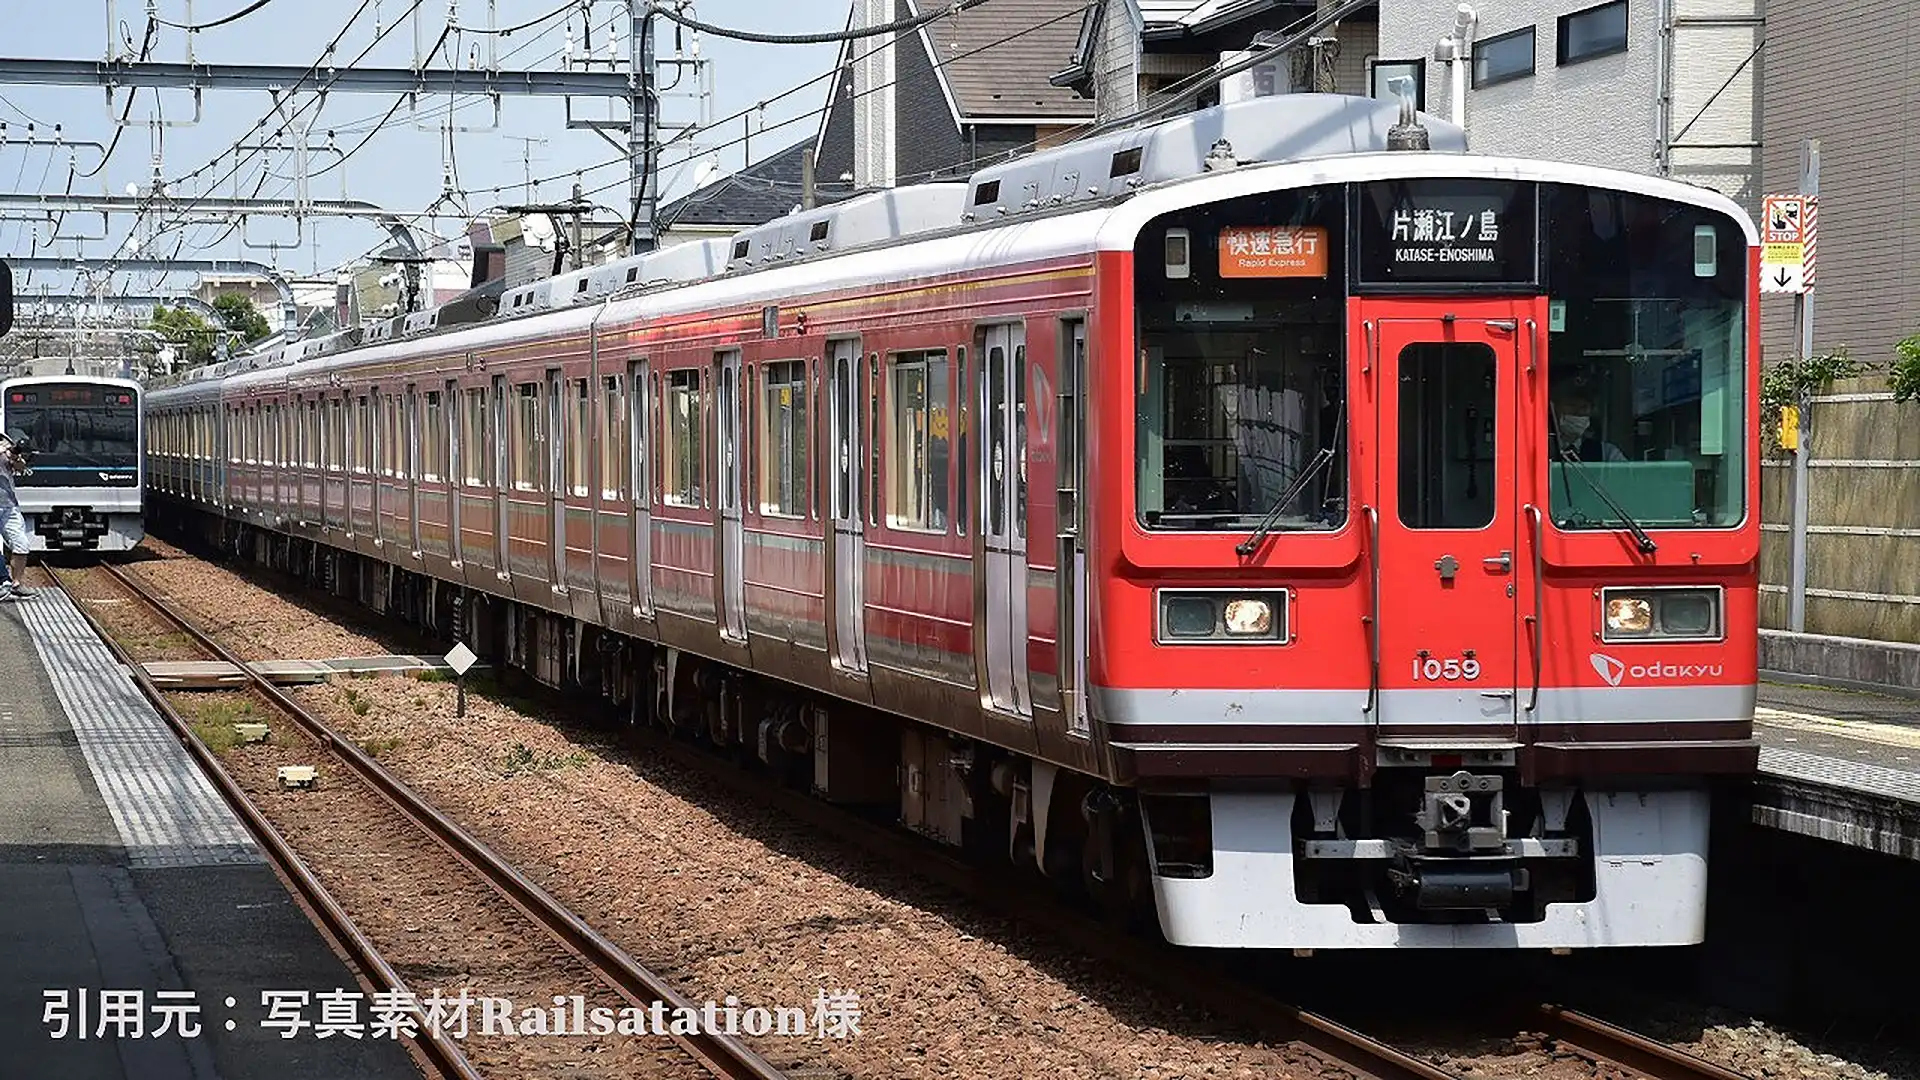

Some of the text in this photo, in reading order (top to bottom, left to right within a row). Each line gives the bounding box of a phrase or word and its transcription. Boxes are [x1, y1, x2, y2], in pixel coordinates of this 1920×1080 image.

[1391, 209, 1499, 241] 片瀬江ノ島
[1226, 230, 1318, 256] 快速急行
[1769, 232, 1800, 241] STOP
[1238, 258, 1306, 268] Rapid Express
[1395, 248, 1495, 262] KATASE-ENOSHIMA
[1412, 659, 1481, 680] 1059
[1629, 661, 1723, 678] odakyu
